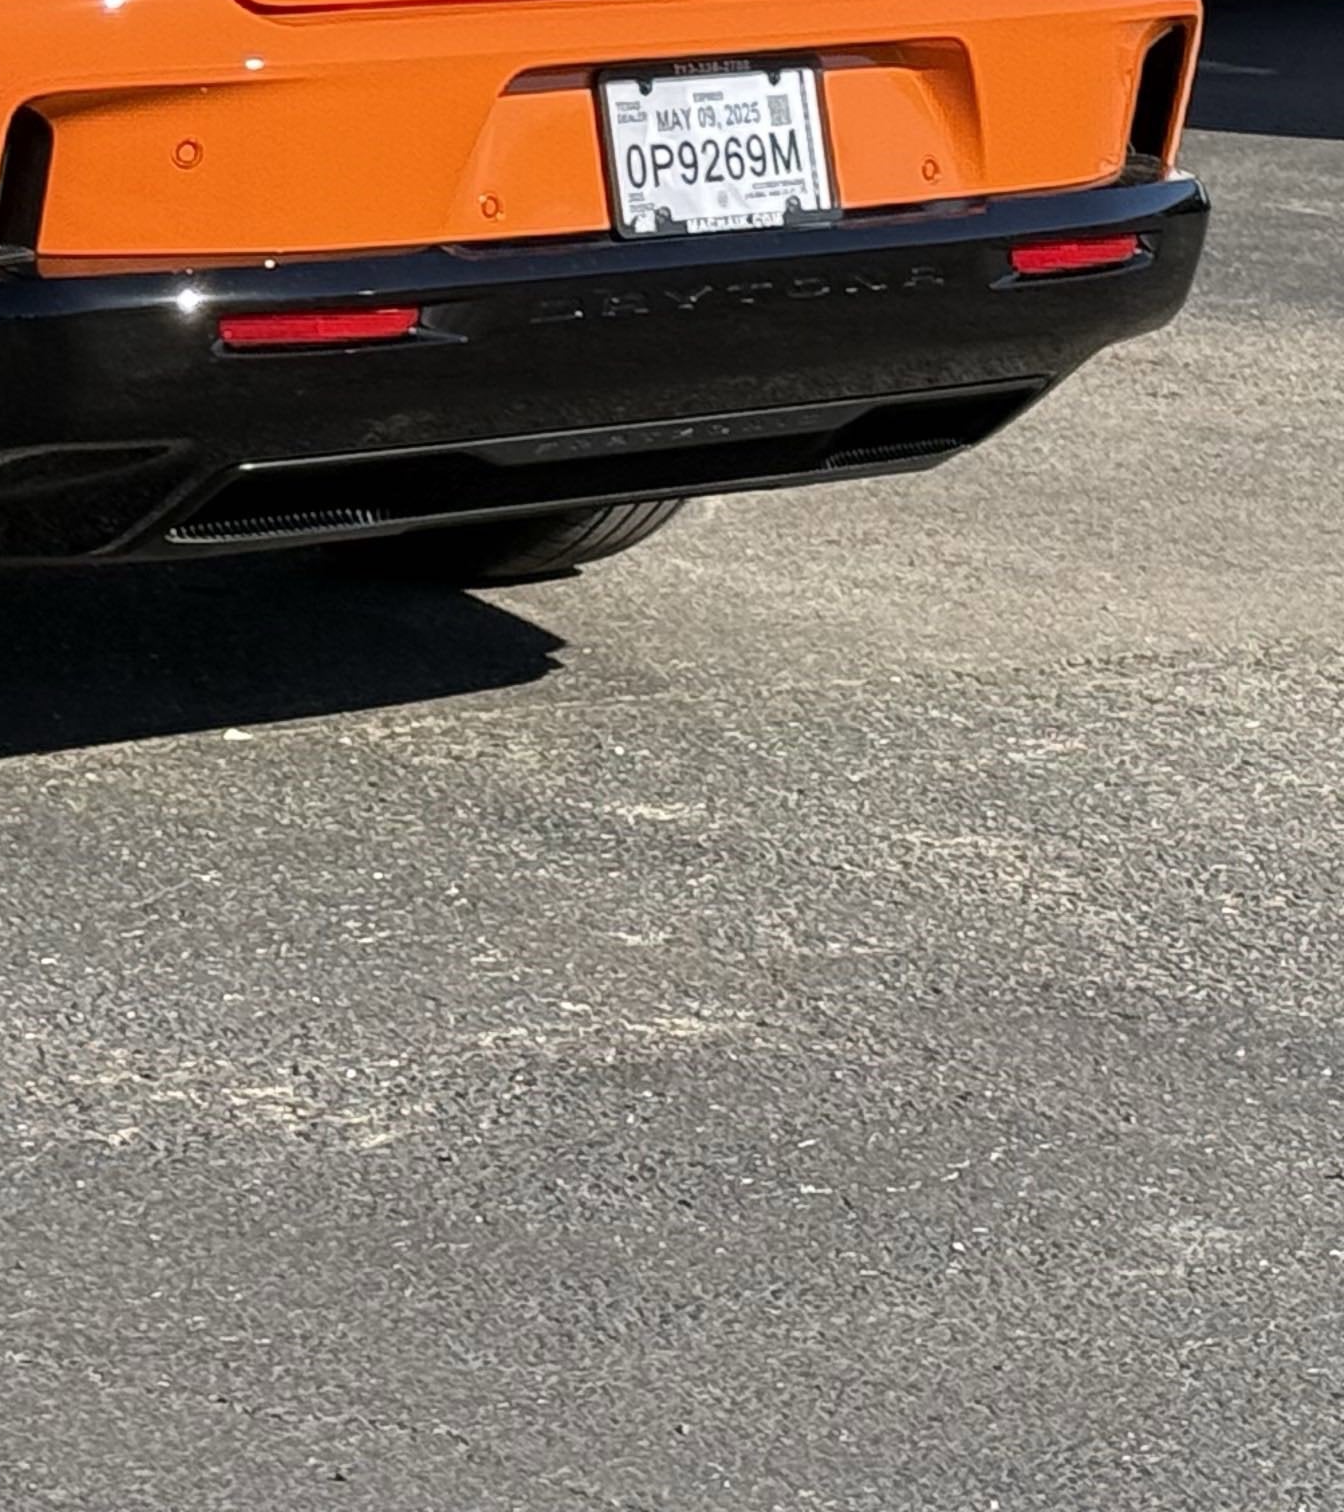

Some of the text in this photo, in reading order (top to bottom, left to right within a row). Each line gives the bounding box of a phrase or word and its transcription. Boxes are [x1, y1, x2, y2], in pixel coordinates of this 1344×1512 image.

[656, 102, 761, 133] MAY 09, 2025
